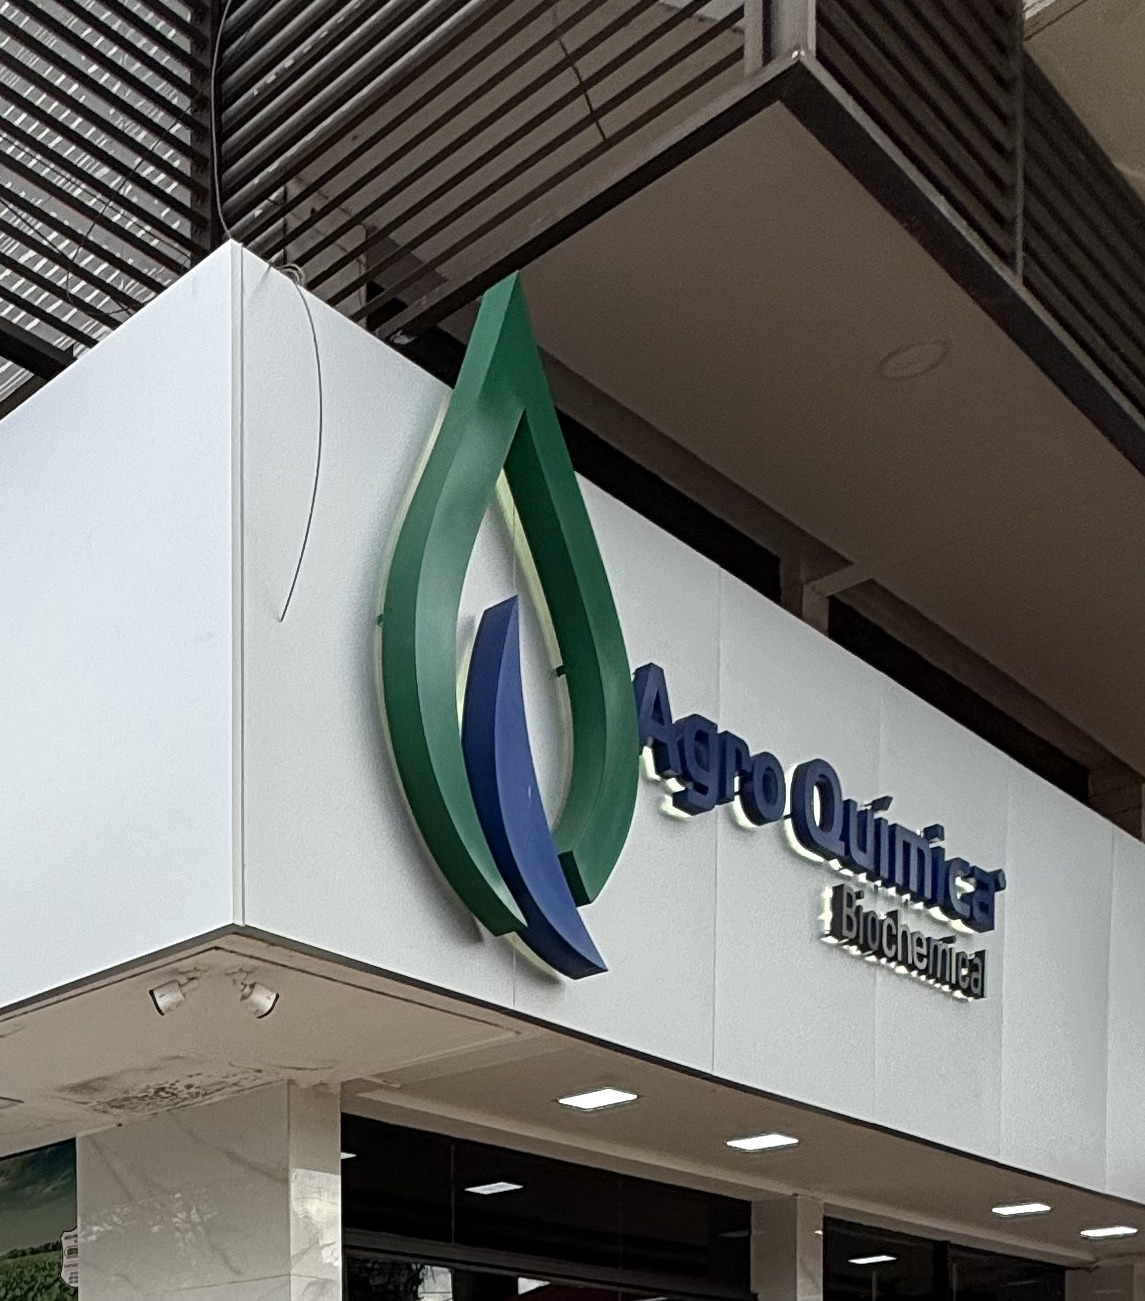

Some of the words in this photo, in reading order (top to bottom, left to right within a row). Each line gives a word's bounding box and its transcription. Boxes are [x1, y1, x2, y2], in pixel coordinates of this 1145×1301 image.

[632, 662, 787, 824] Agro
[788, 759, 998, 931] Química
[828, 884, 986, 998] Biochemical
